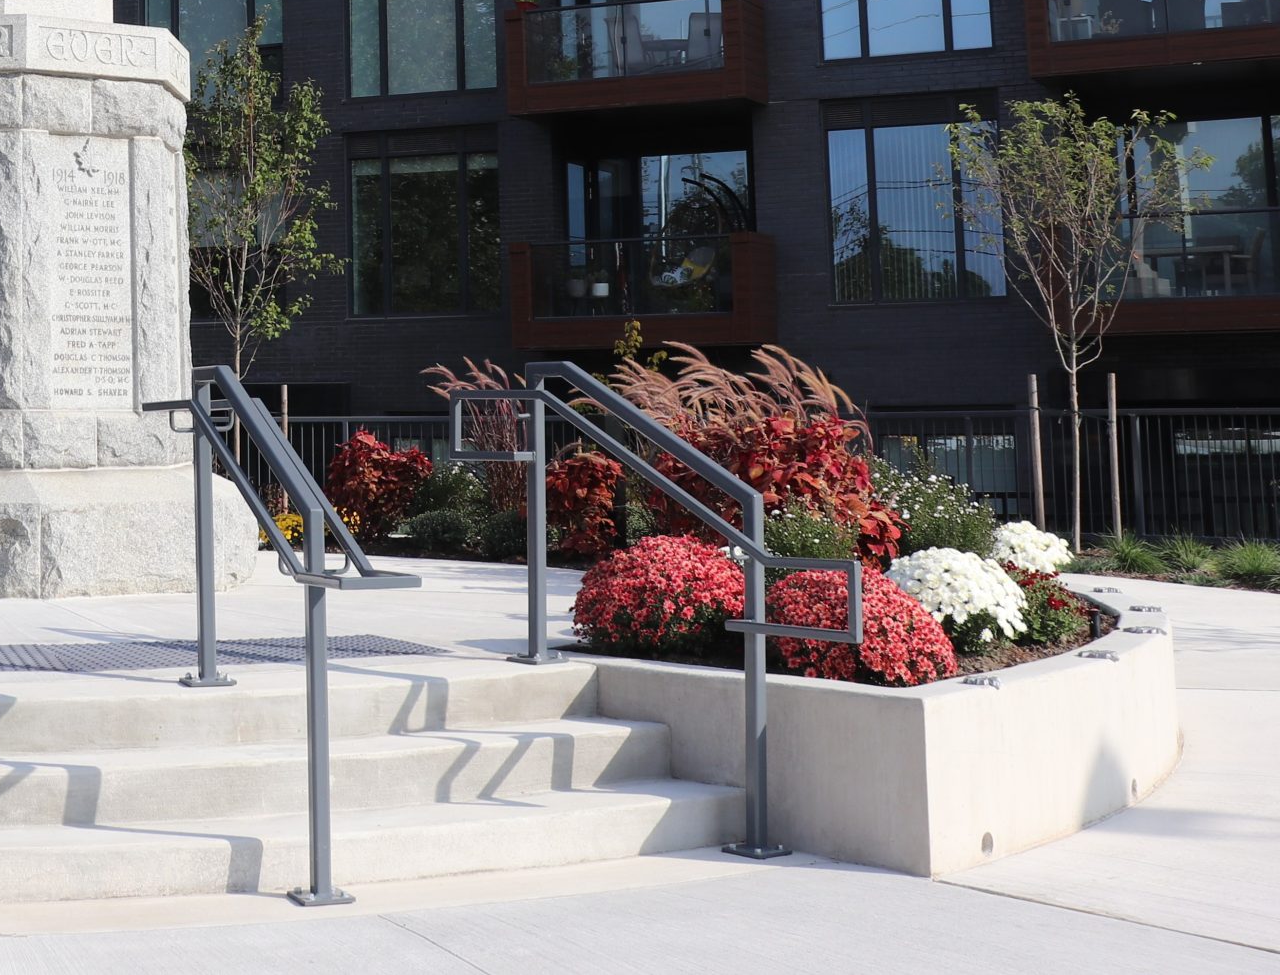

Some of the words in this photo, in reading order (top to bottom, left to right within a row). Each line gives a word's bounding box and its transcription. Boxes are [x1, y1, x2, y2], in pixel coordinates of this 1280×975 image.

[52, 168, 76, 184] 1914
[103, 170, 126, 187] 1918
[102, 200, 115, 208] LEE
[65, 211, 84, 219] JOHN
[56, 236, 79, 245] FRANK
[65, 250, 97, 258] STANLEY
[77, 288, 111, 297] ROSSITER
[60, 327, 87, 335] ADRIAN
[67, 340, 87, 348] FRED
[53, 353, 87, 361] DOUGLAS
[53, 388, 84, 396] HOWARD
